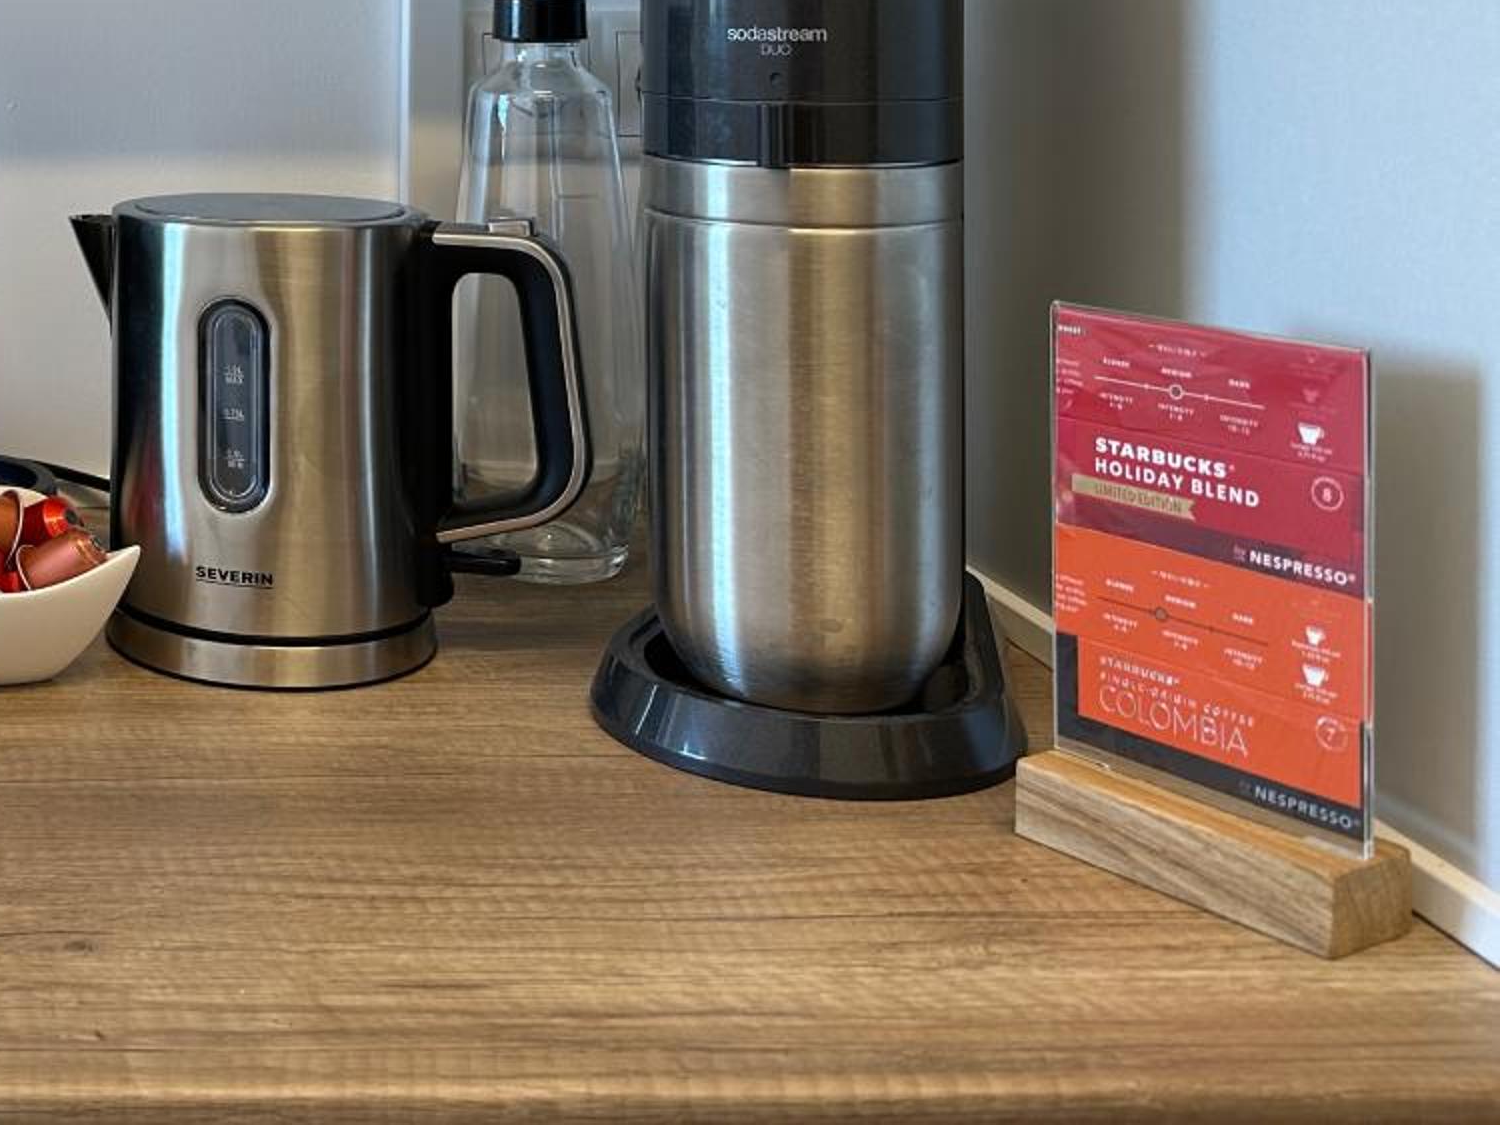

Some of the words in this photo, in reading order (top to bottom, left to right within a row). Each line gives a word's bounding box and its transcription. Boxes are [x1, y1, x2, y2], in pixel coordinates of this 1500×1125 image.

[727, 25, 828, 43] sodastream
[761, 43, 792, 56] DUO
[1094, 456, 1185, 491] HOLIDAY
[1191, 477, 1260, 508] BLEND
[195, 565, 273, 586] SEVERIN
[1099, 684, 1249, 758] COLOMBIA
